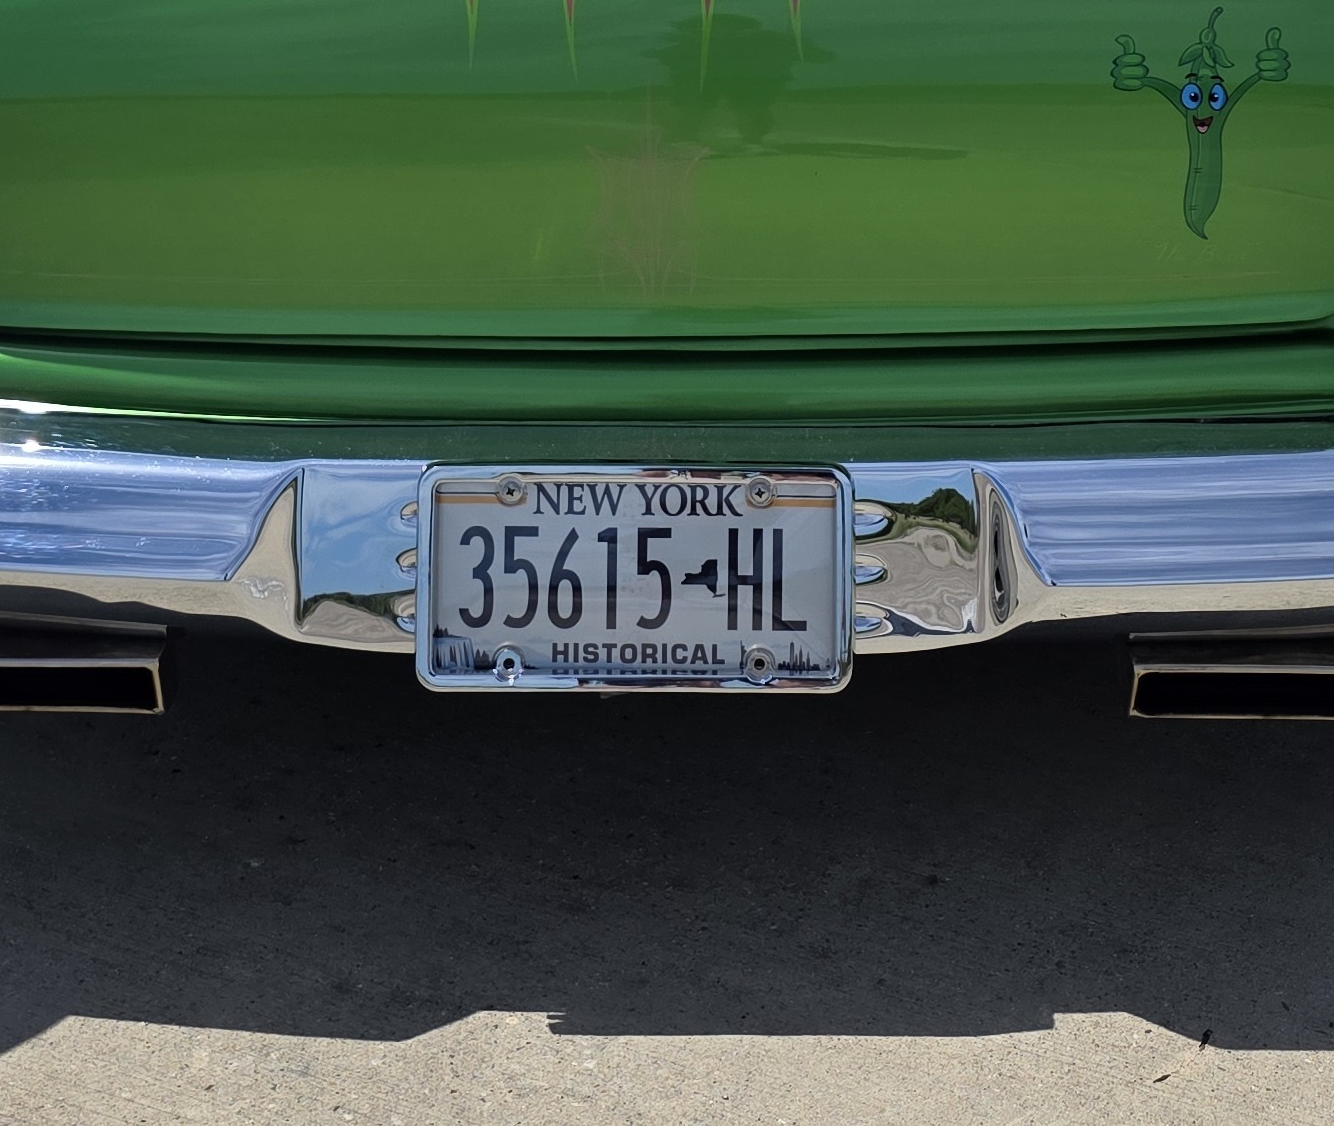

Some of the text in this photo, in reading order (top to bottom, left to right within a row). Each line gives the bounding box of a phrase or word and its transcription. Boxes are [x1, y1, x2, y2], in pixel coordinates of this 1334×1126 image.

[533, 483, 744, 517] NEW YORK
[458, 525, 808, 632] 35615 HL
[552, 642, 725, 665] HISTORICAL
